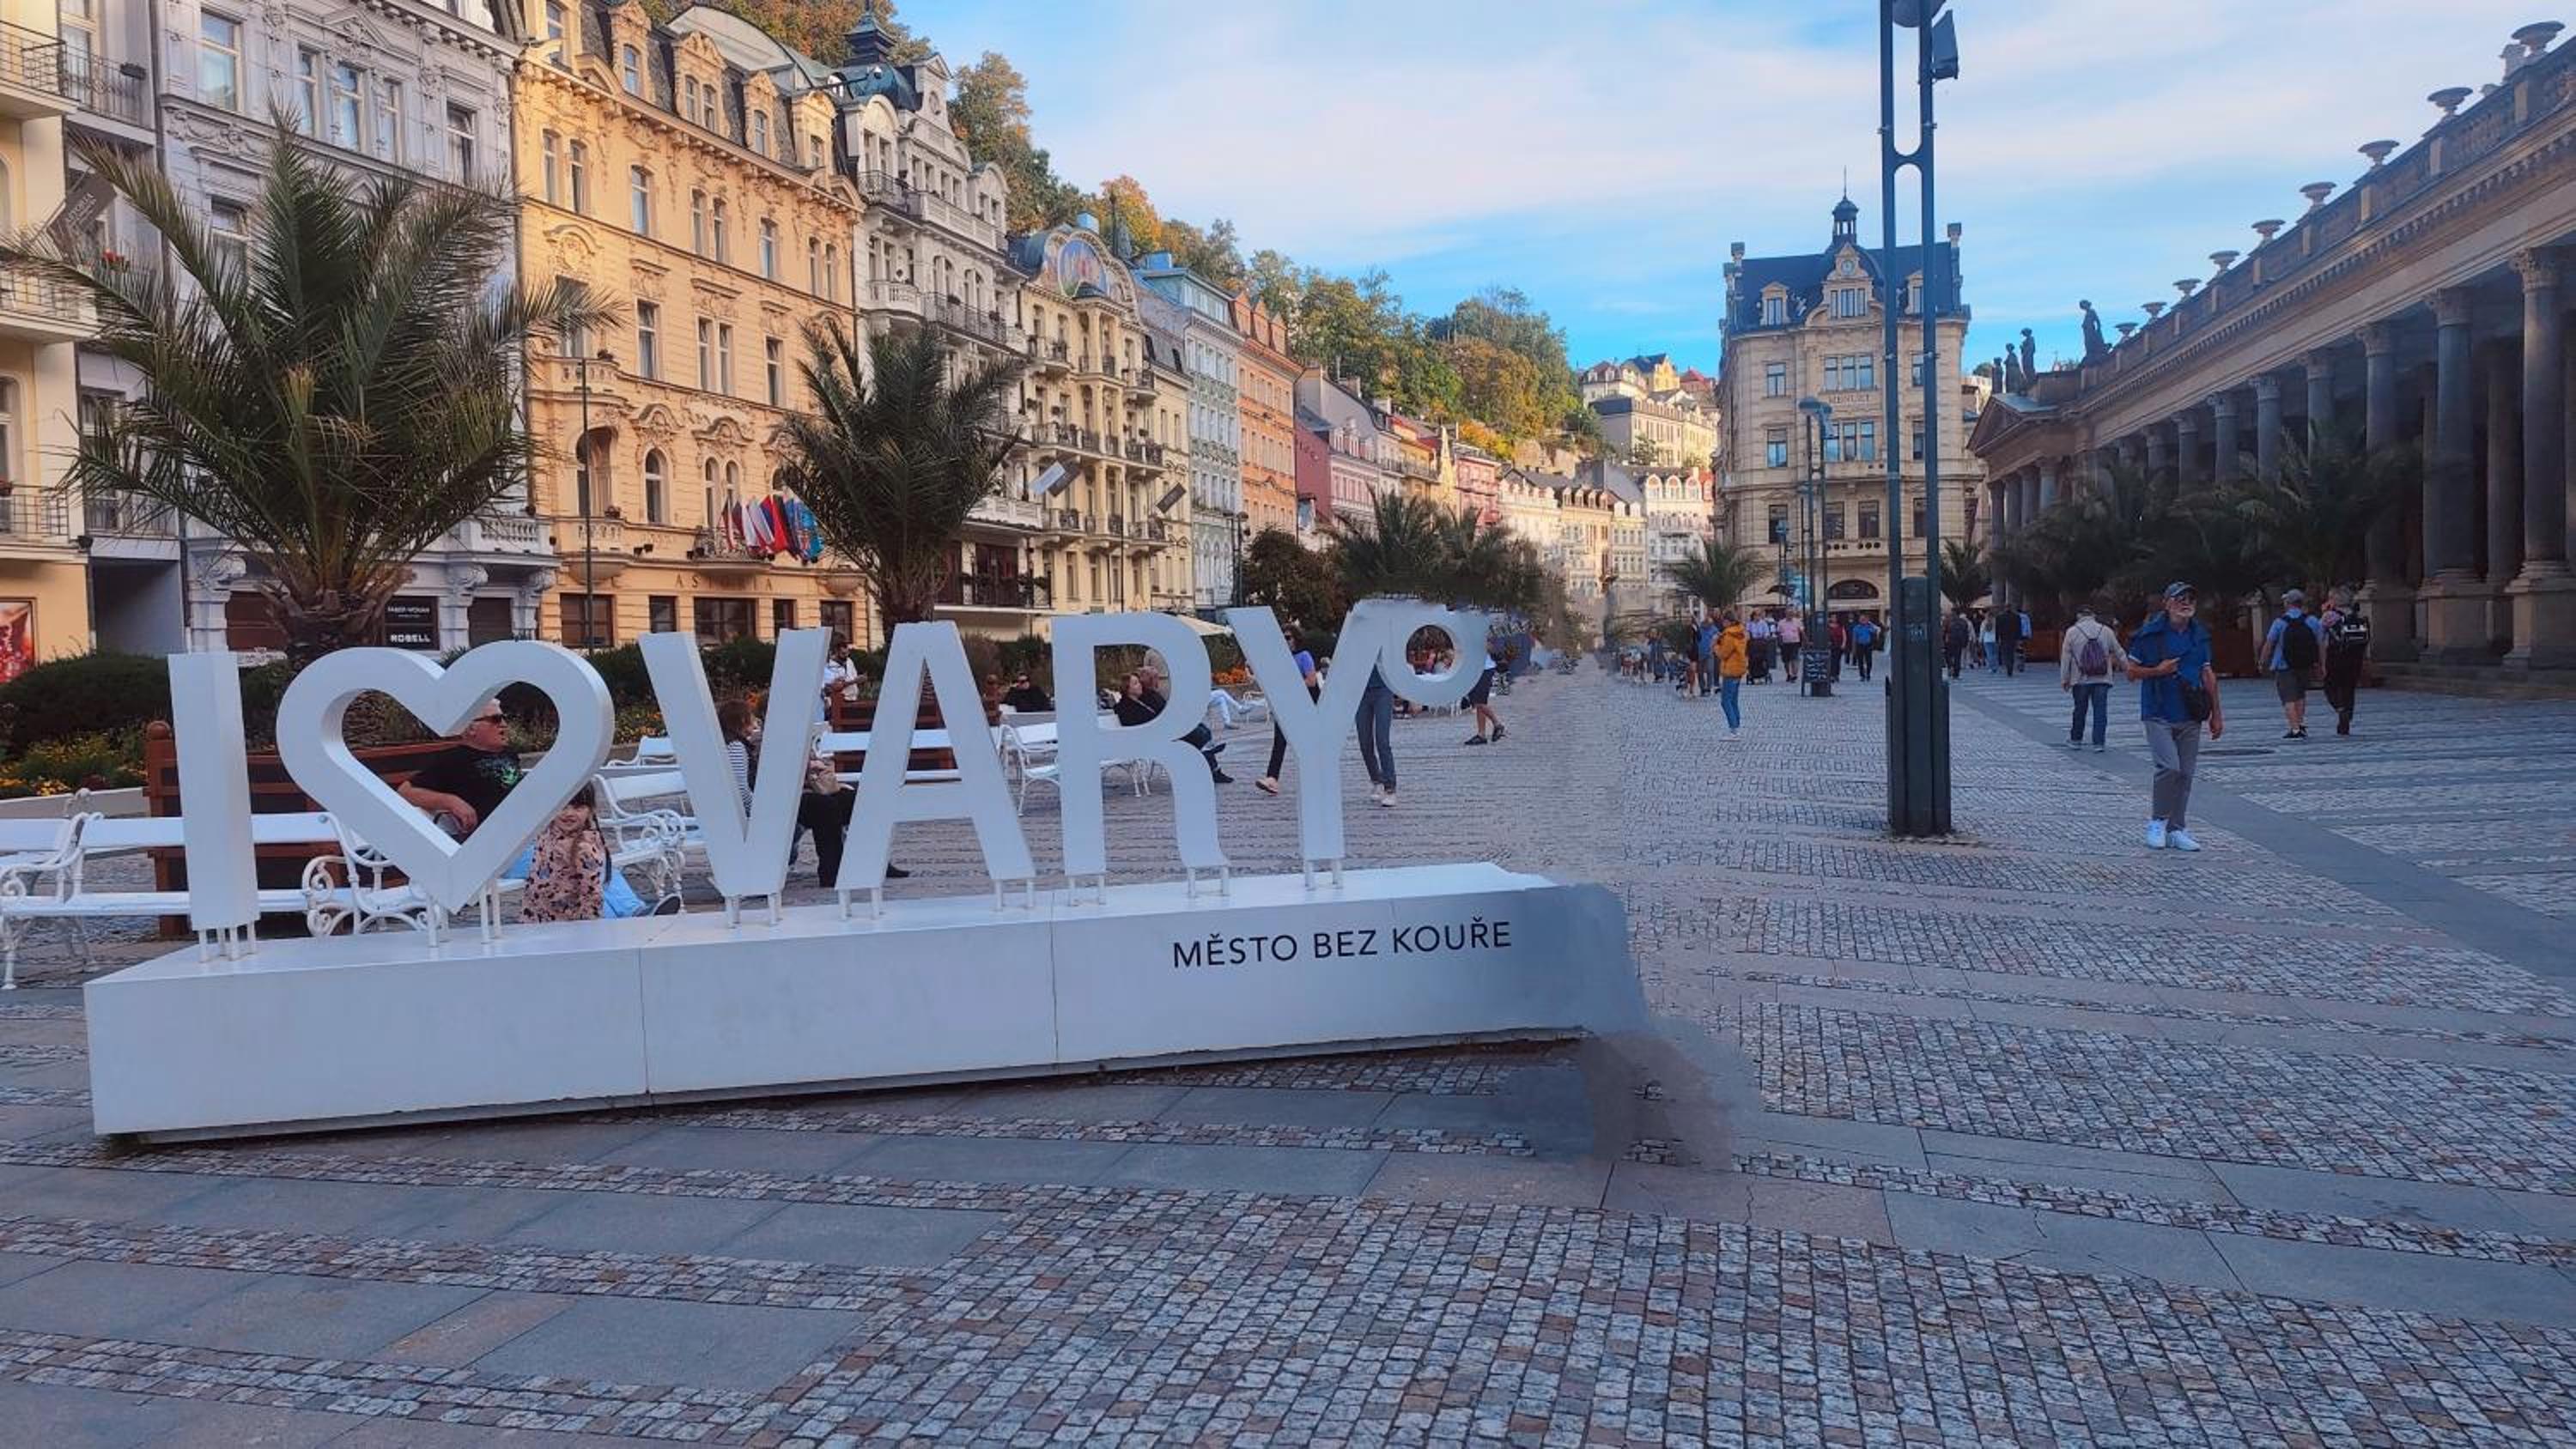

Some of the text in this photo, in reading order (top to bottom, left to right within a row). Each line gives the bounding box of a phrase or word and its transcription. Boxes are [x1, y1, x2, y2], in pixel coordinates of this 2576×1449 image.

[1173, 916, 1512, 968] MĚSTO BEZ KOUŘE
